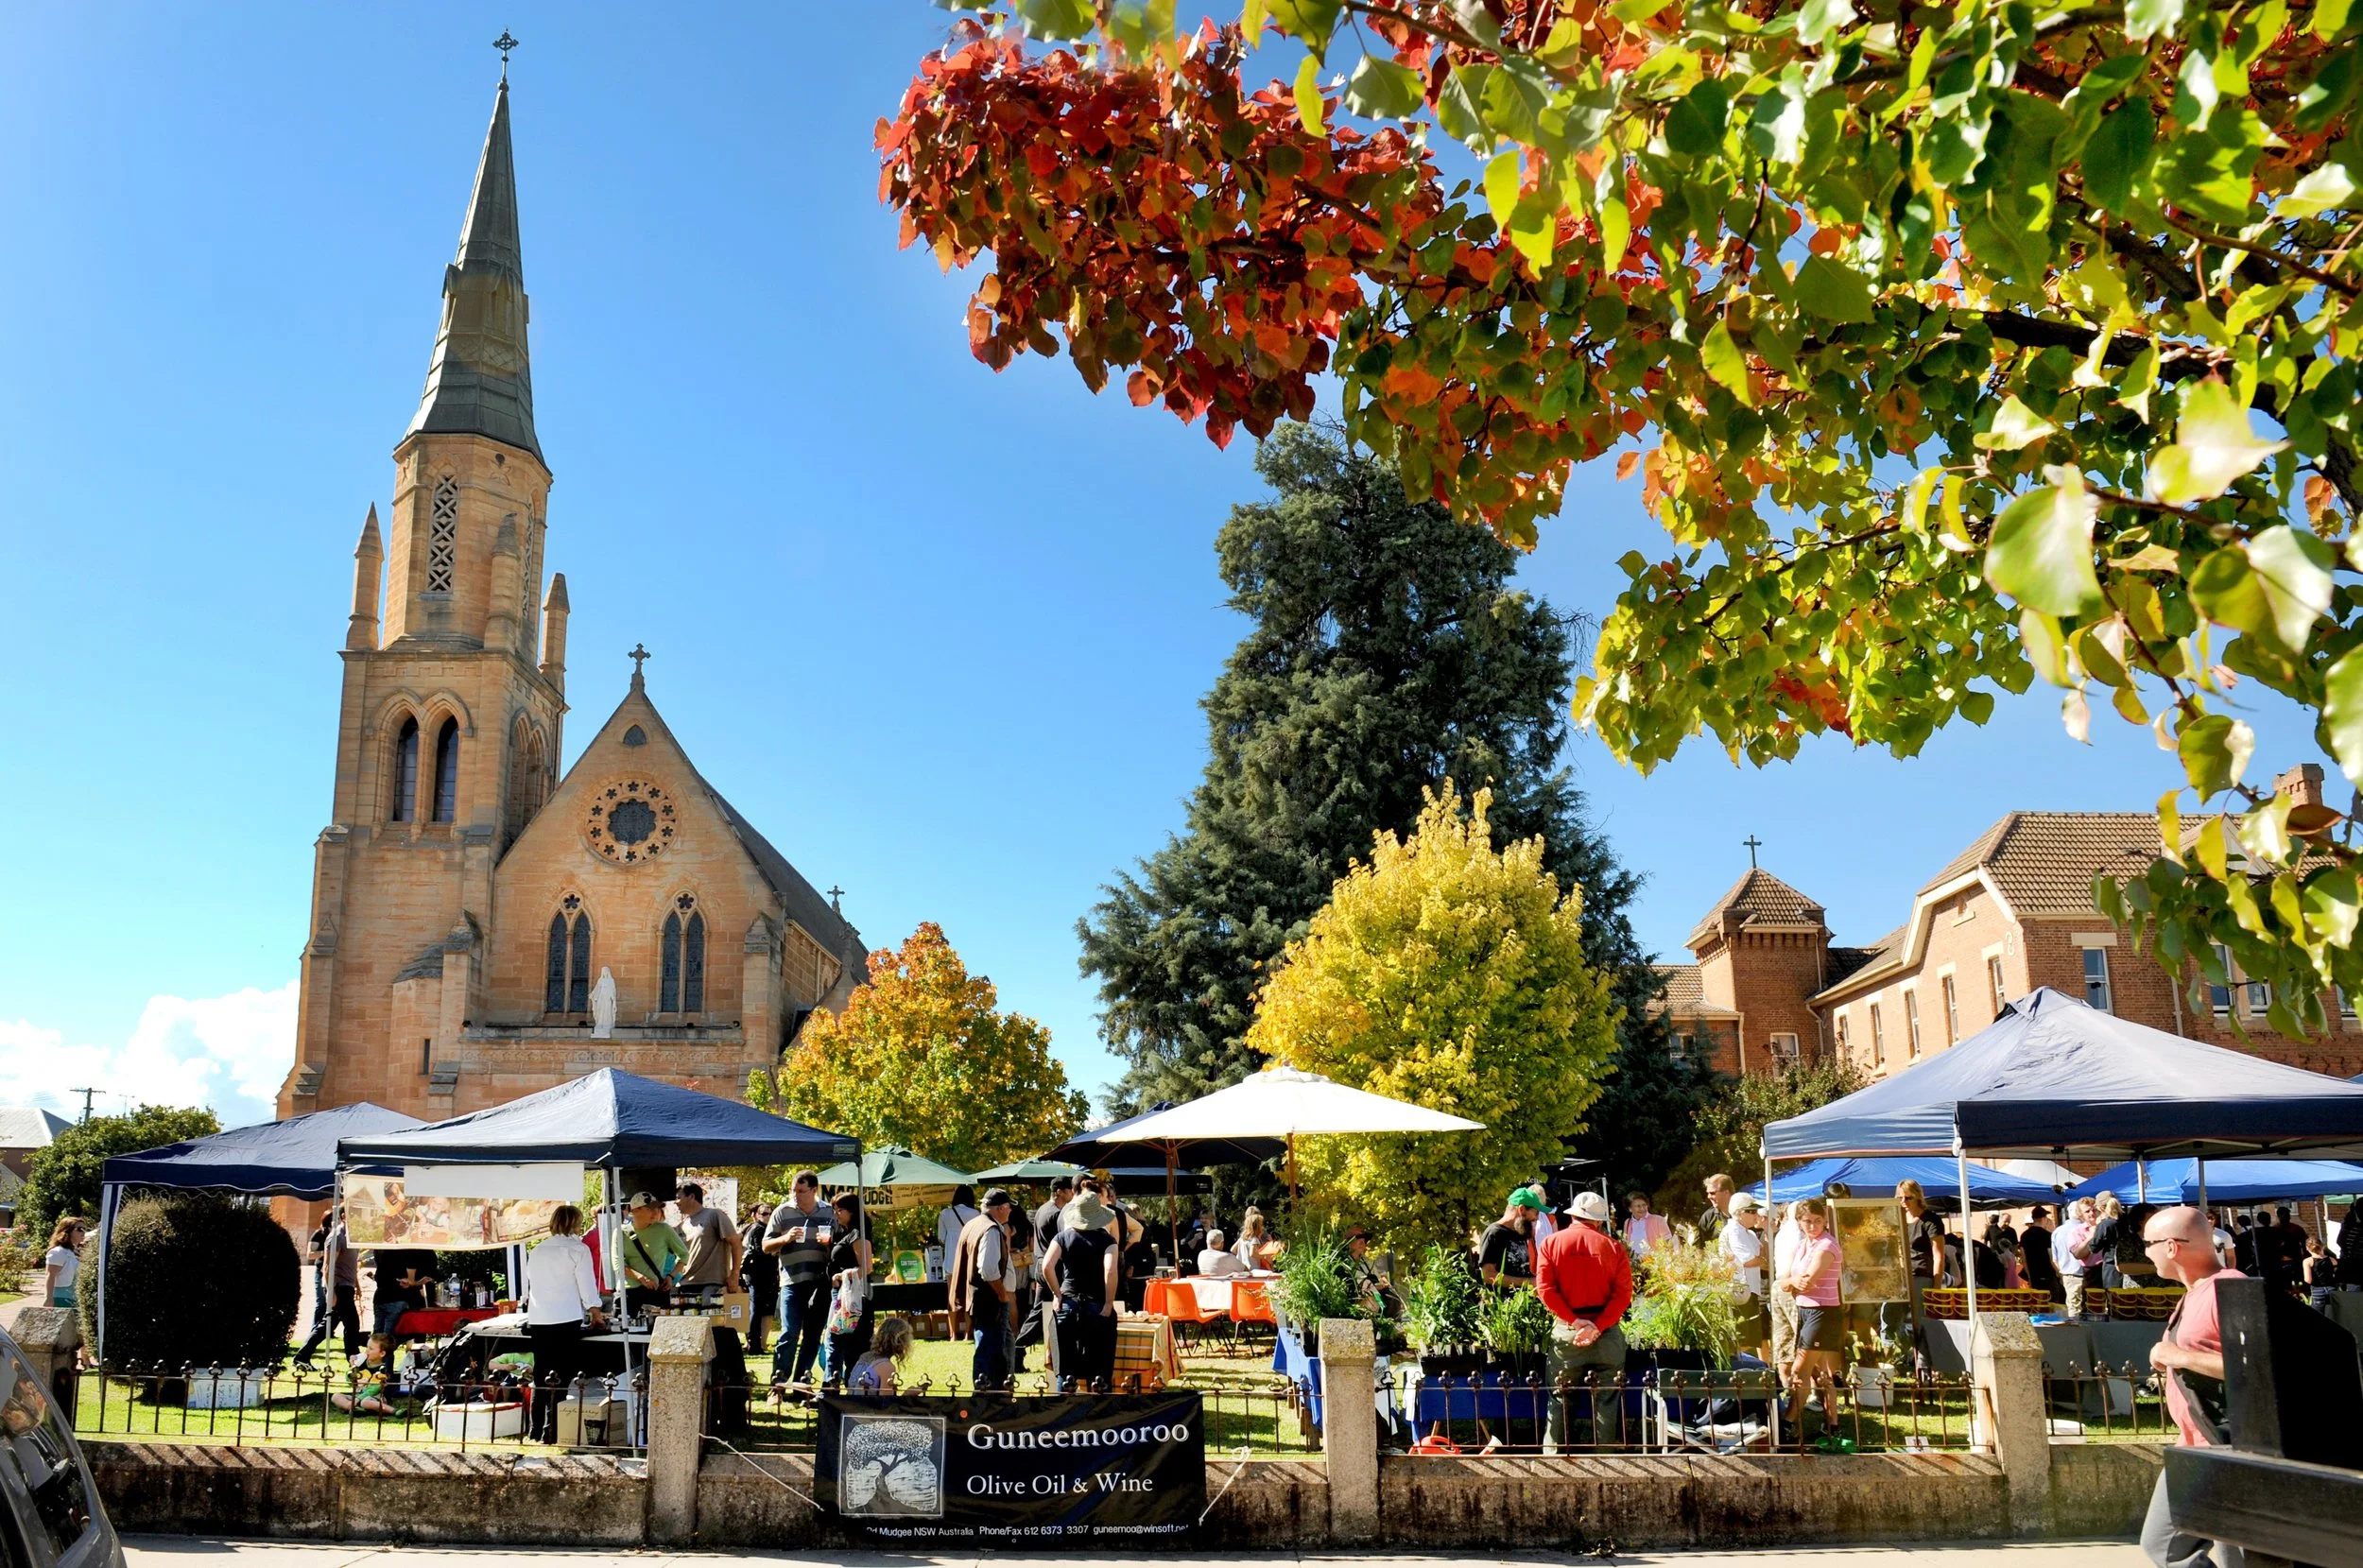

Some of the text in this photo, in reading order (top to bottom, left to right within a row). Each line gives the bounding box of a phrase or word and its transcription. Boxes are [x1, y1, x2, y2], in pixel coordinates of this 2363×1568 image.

[967, 1423, 1189, 1450] Guneemooroo
[967, 1473, 1153, 1494] Olive Oil & Wine
[879, 1527, 912, 1538] Mudgee
[914, 1526, 937, 1536] NSW
[939, 1527, 974, 1536] Australia
[979, 1526, 1022, 1536] Phone/Fax
[1024, 1526, 1039, 1535] 612
[1041, 1525, 1062, 1535] 6373
[1066, 1525, 1089, 1534] 3307
